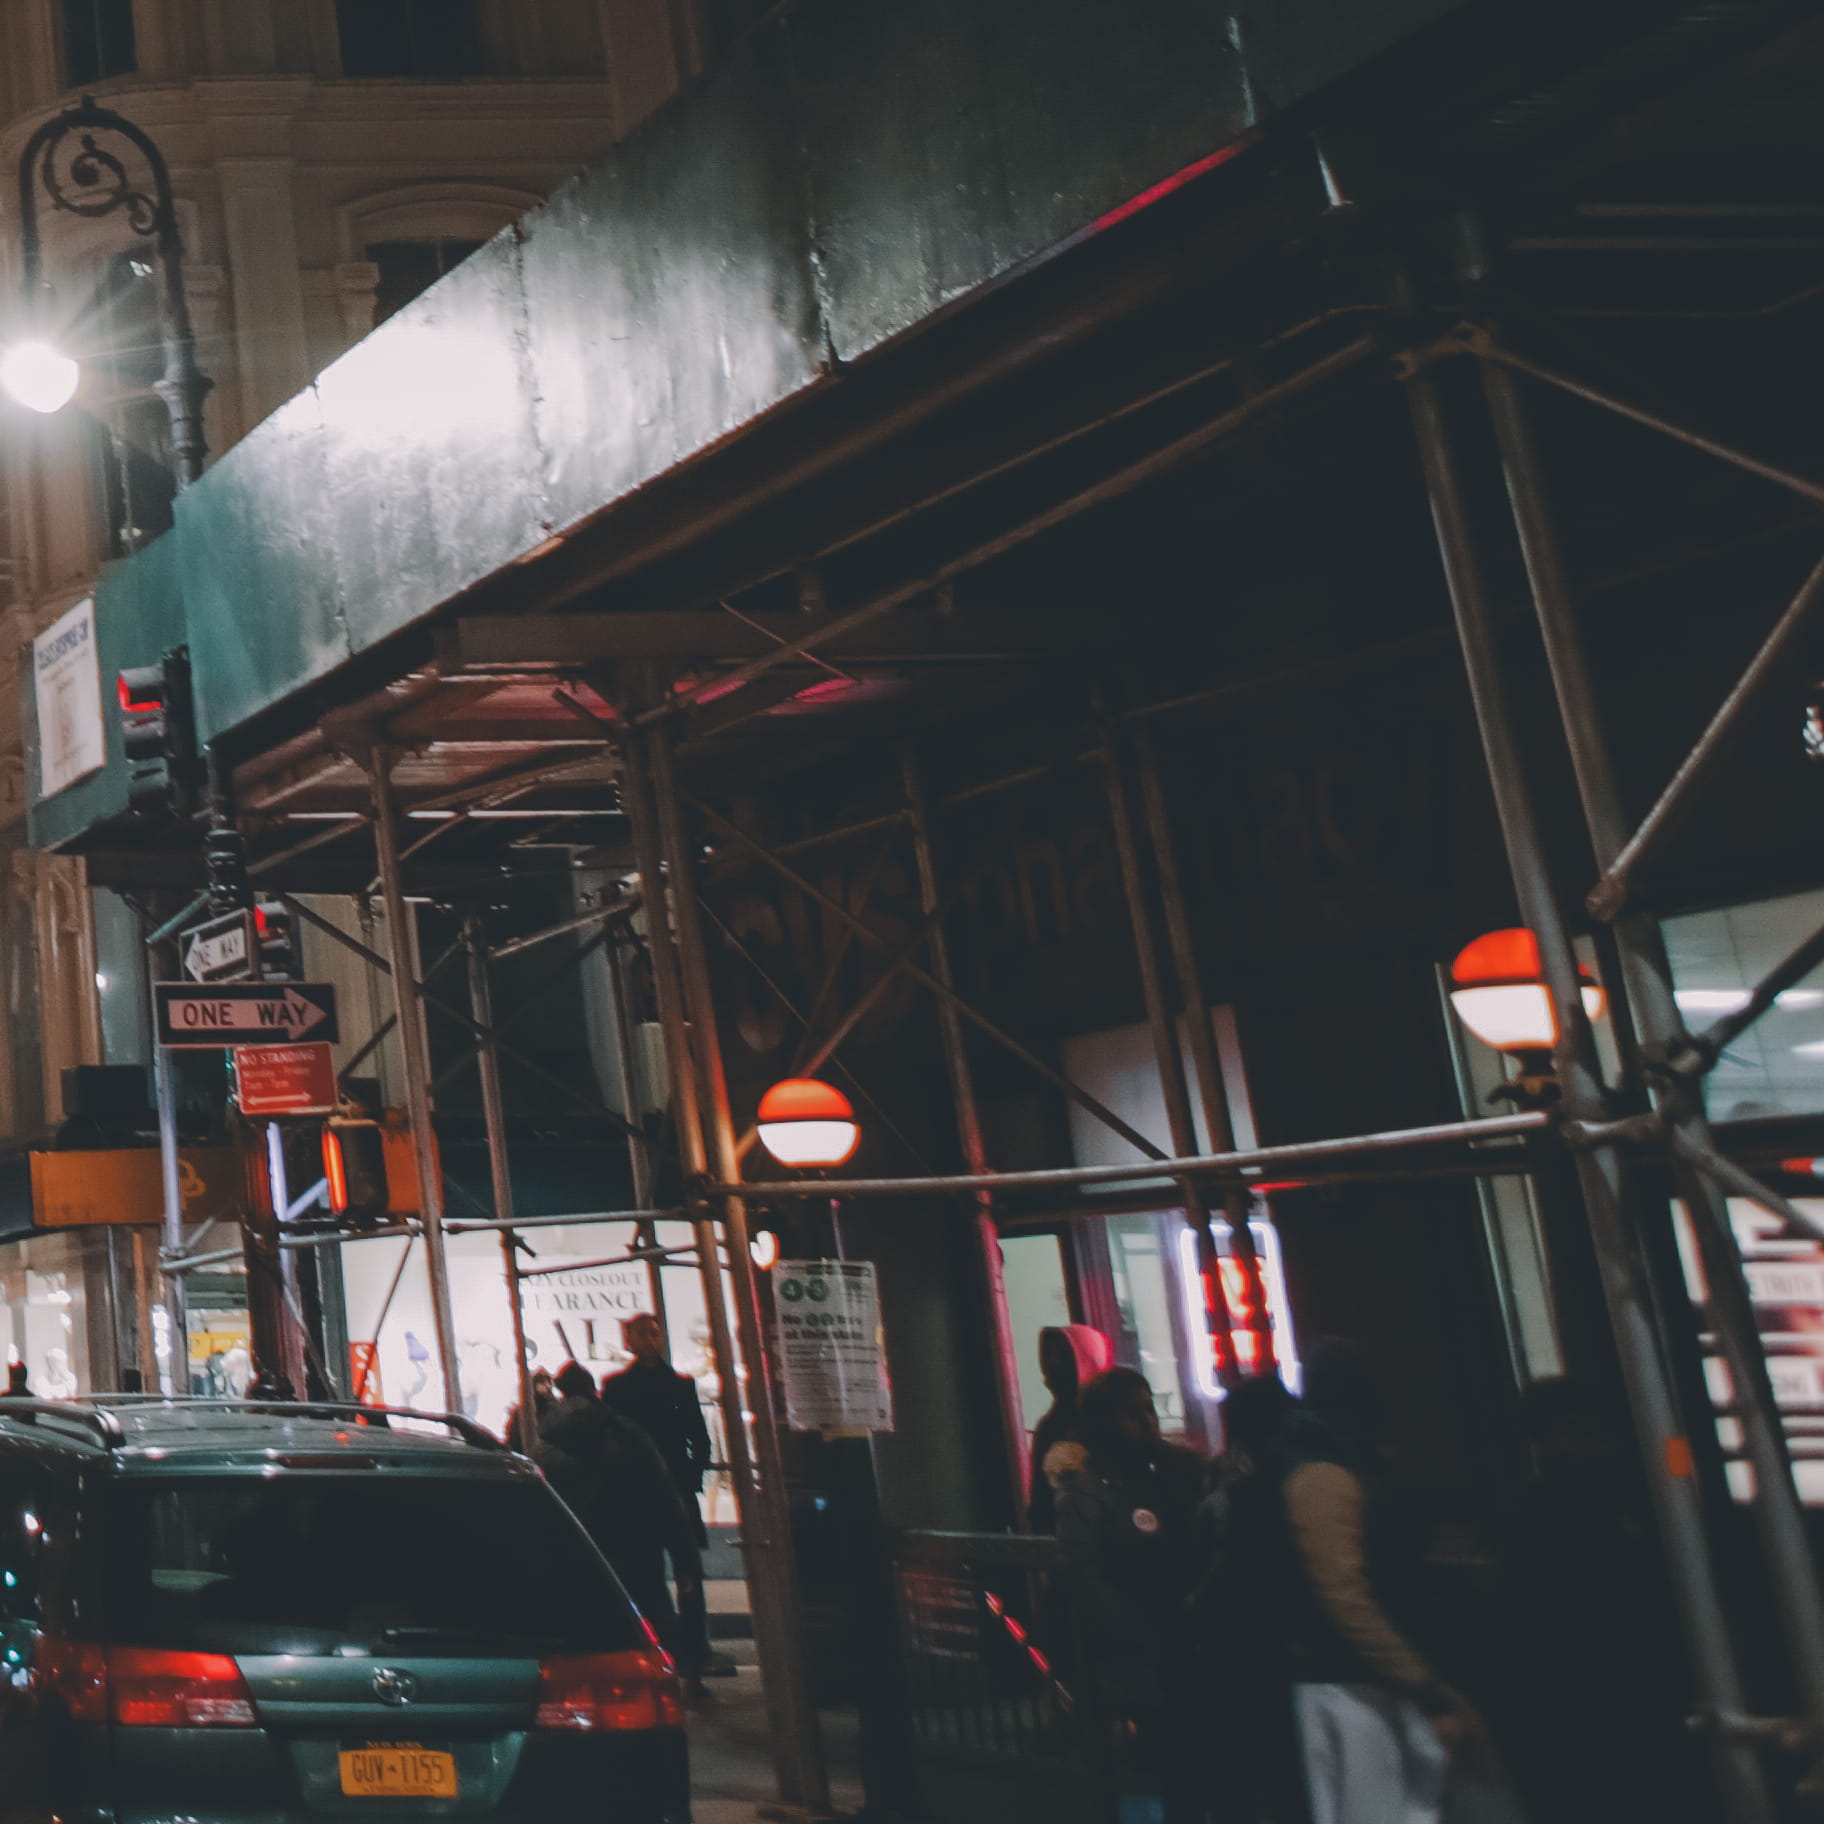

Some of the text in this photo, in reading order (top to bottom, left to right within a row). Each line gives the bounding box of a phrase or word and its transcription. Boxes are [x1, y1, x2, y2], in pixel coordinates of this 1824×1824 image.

[183, 1002, 309, 1026] ONE WAY
[240, 1049, 316, 1066] NO STANDING
